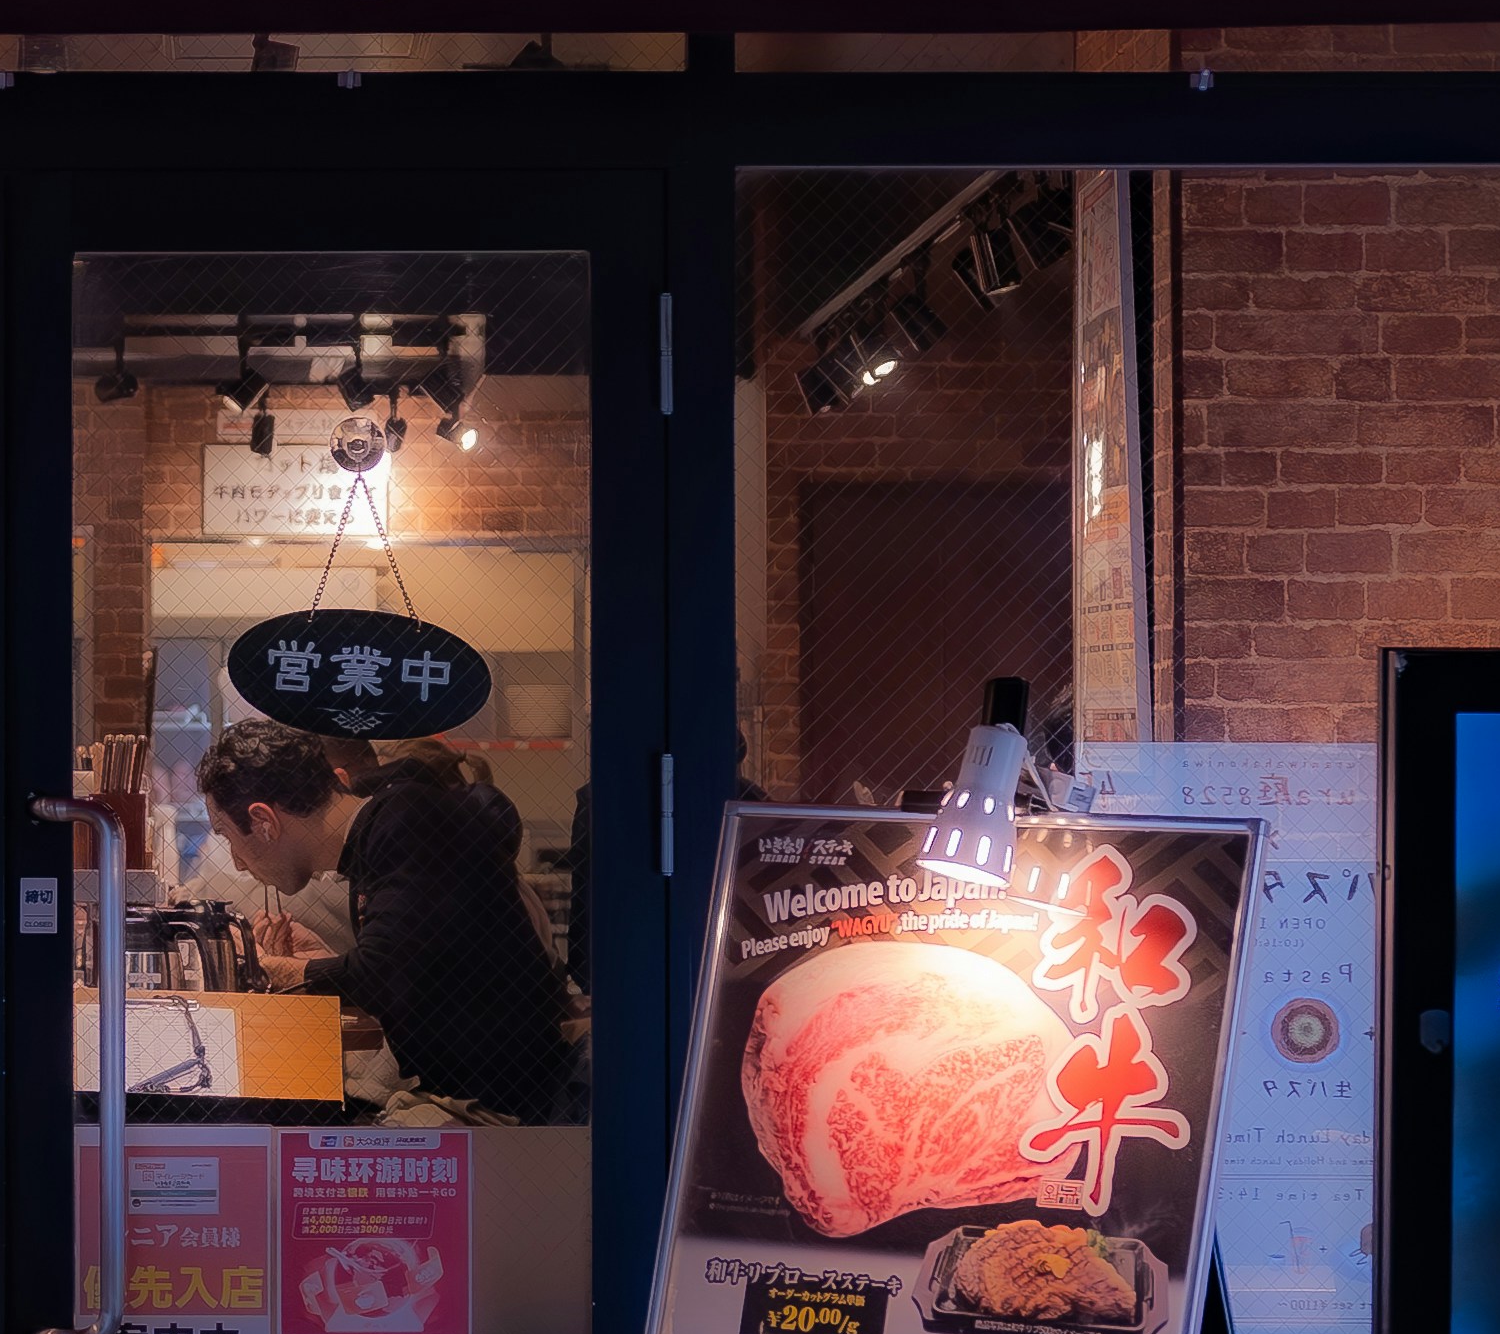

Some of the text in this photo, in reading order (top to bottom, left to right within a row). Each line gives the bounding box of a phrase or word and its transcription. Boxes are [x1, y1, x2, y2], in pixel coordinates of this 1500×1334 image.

[267, 640, 451, 702] 営業中
[758, 837, 854, 855] いきなり ステーキ
[24, 888, 54, 907] 締切
[763, 874, 916, 924] Welcome to
[23, 920, 54, 929] CLOSED
[741, 925, 830, 959] Please enjoy
[1021, 844, 1196, 1216] 和牛
[292, 1157, 458, 1184] 寻味环游时刻
[706, 1258, 902, 1296] 和牛リブロースステーキ
